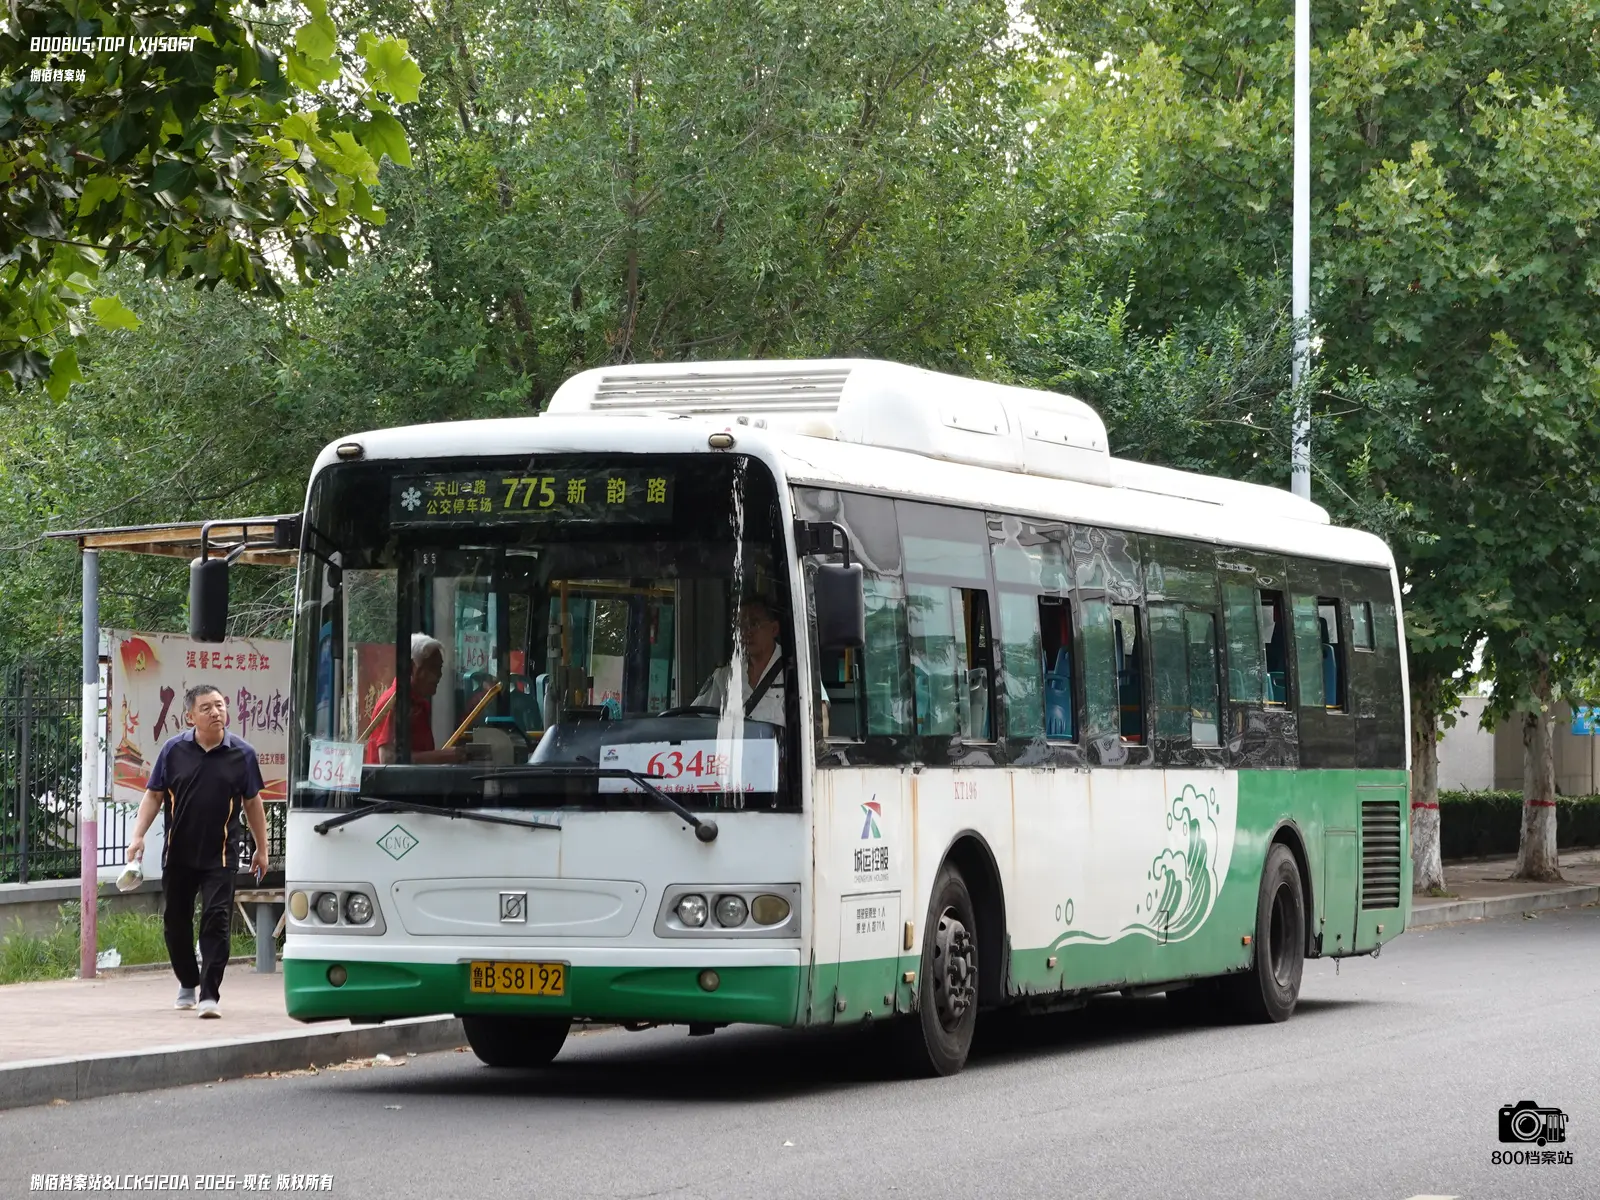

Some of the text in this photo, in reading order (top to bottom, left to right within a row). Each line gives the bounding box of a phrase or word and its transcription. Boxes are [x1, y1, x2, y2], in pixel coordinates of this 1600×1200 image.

[502, 478, 666, 507] 775 新韵路
[427, 497, 492, 515] 公交停车场
[187, 651, 270, 671] 温馨巴士党旗红
[312, 760, 344, 782] 634
[385, 836, 410, 850] CNG
[854, 846, 889, 873] 城运控股
